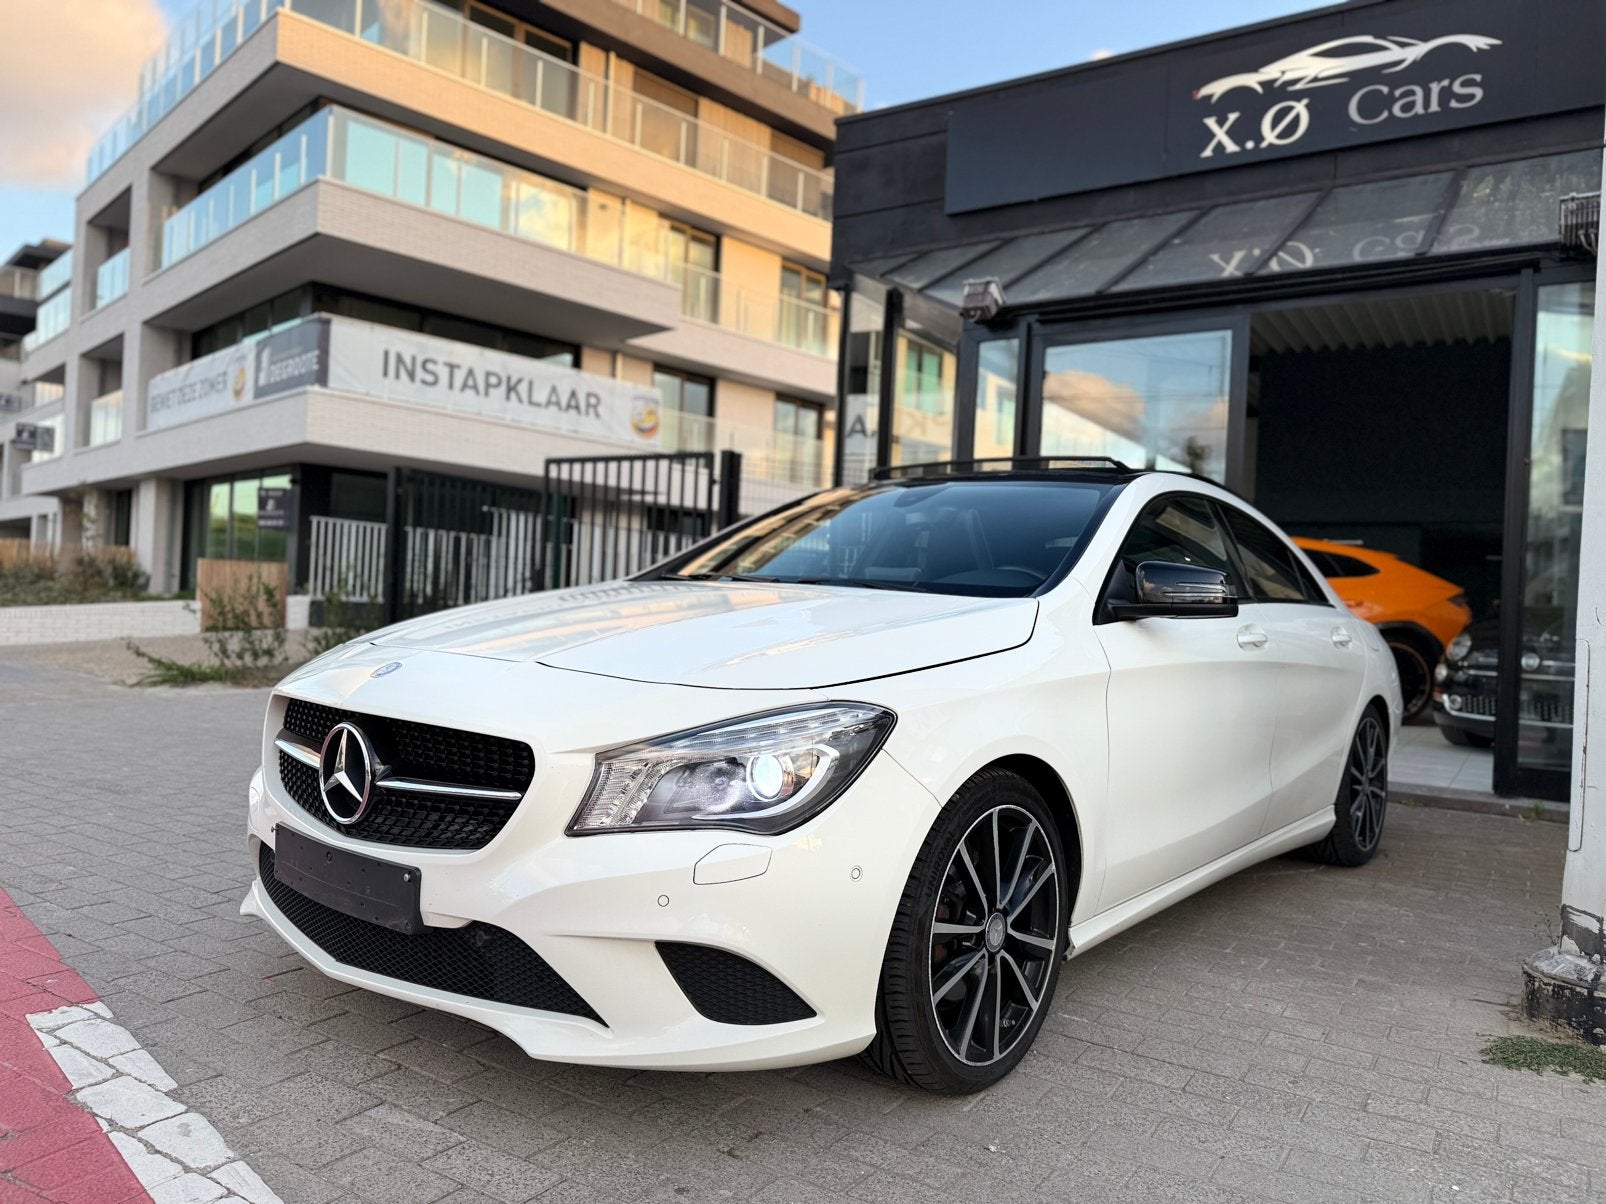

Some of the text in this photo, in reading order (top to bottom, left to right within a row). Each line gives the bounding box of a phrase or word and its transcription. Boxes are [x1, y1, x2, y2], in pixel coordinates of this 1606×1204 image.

[1348, 73, 1485, 126] Cars
[382, 349, 602, 420] INSTAPKLAAR
[925, 831, 956, 897] UNIROYAL
